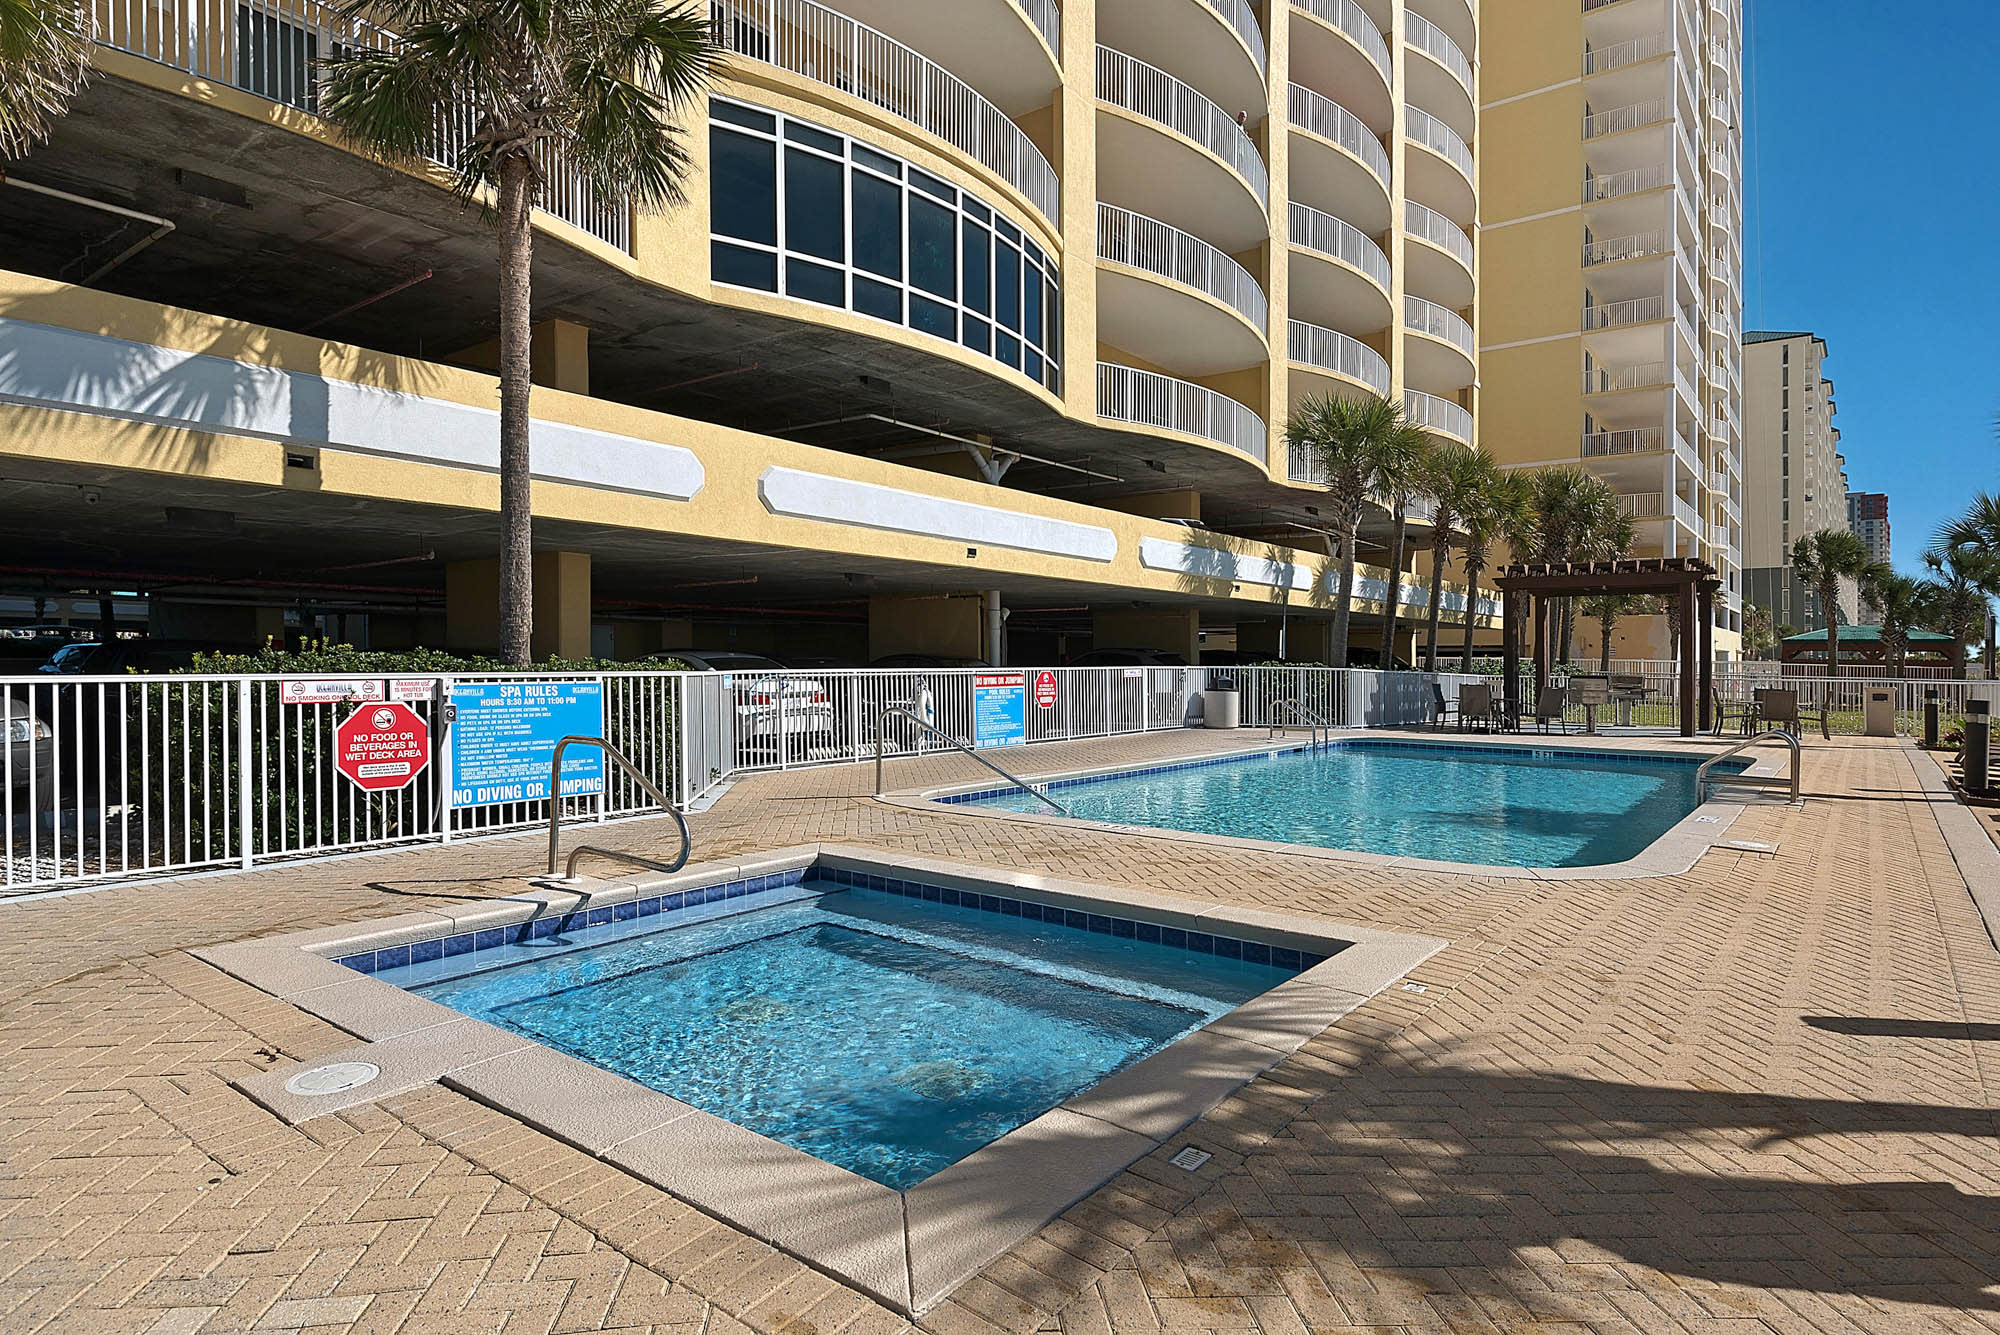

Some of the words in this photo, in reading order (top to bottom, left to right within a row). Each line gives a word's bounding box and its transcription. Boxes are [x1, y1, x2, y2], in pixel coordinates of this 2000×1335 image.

[500, 686, 521, 697] SPA
[525, 685, 558, 696] RULES
[354, 734, 368, 742] NO
[371, 733, 397, 741] FOOD
[350, 742, 406, 752] BEVERAGES
[369, 751, 395, 760] DECK
[397, 750, 422, 758] AREA
[454, 789, 472, 804] NO
[478, 785, 522, 802] DIVING
[526, 782, 543, 797] OR
[548, 777, 602, 795] MPING
